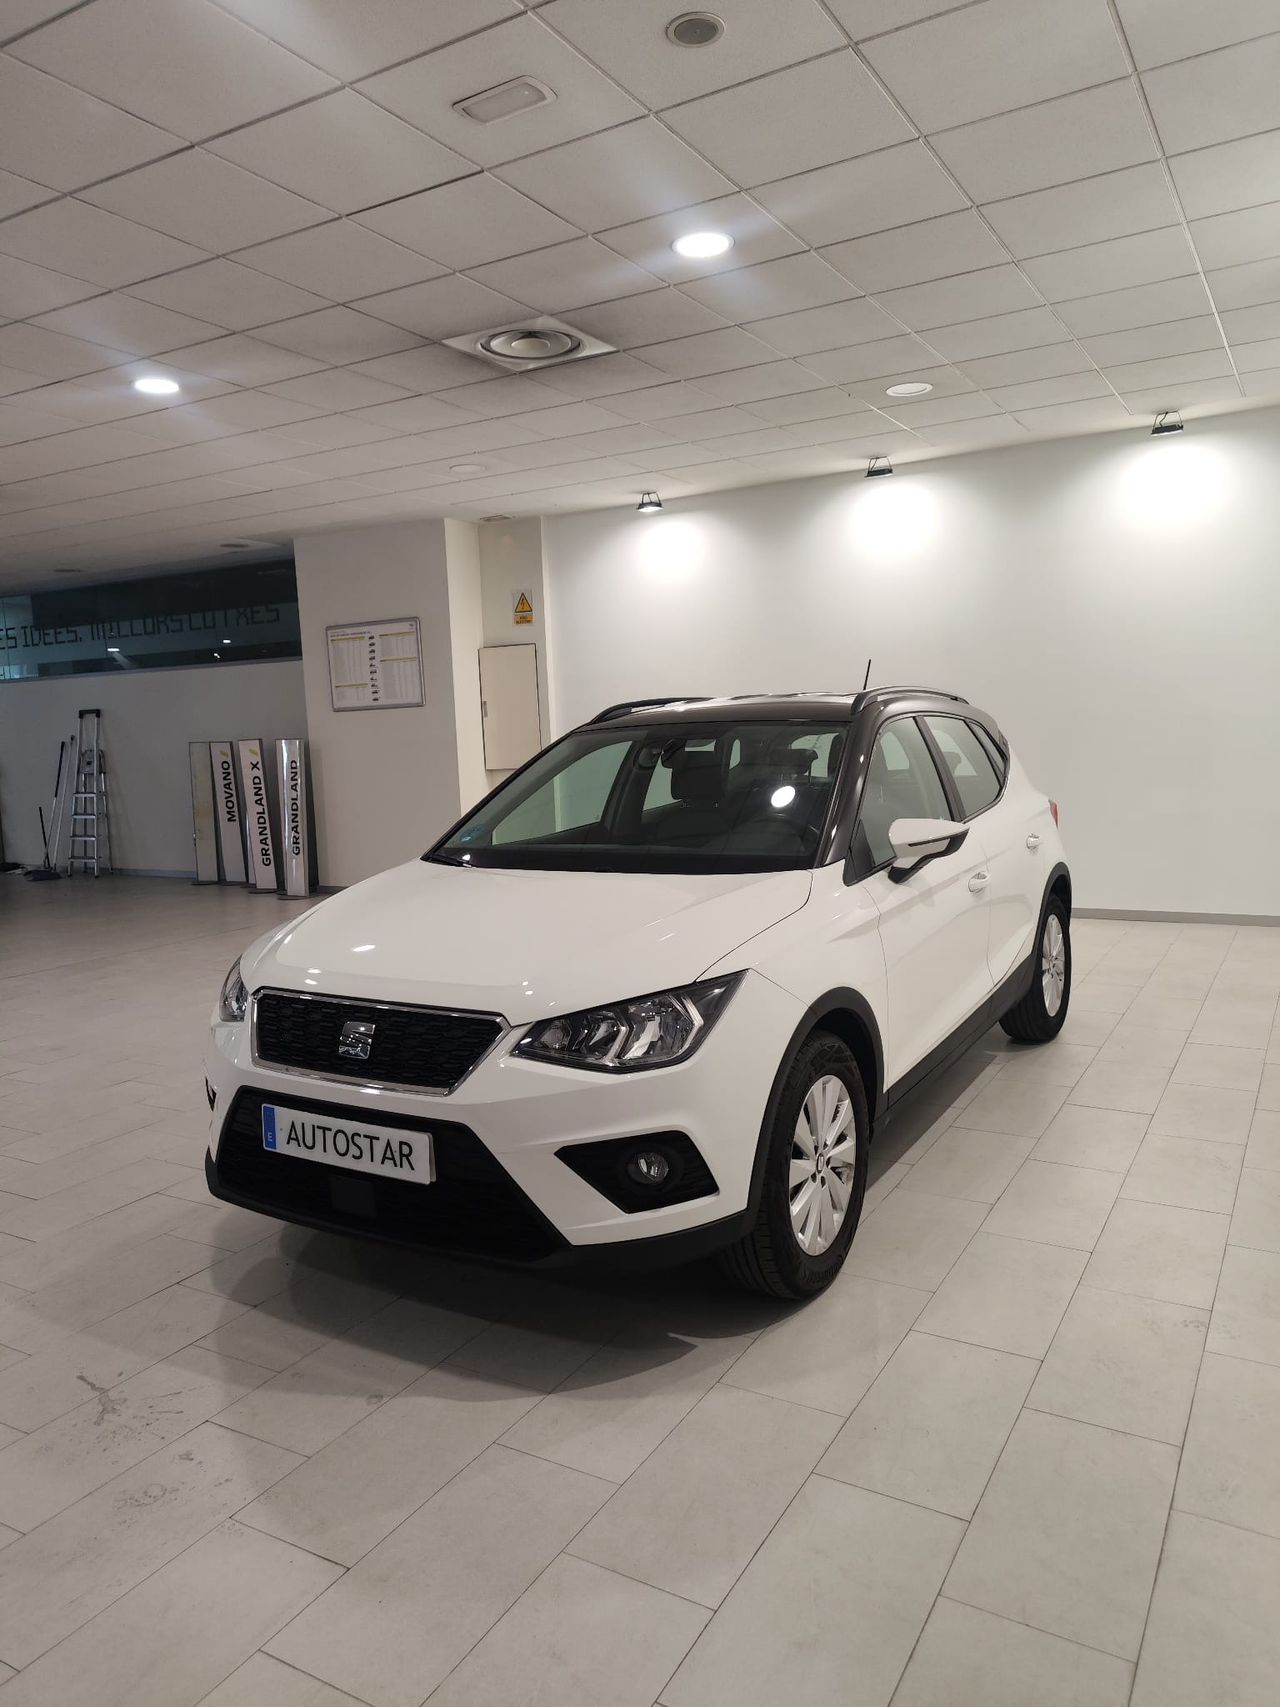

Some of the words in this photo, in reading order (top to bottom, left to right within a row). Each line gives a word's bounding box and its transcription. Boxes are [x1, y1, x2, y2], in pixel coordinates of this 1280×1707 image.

[221, 760, 237, 822] MOVANO
[250, 760, 261, 771] X
[252, 776, 271, 867] GRANDLAND
[290, 759, 300, 856] GRANDLAND
[286, 1120, 415, 1171] AUTOSTAR
